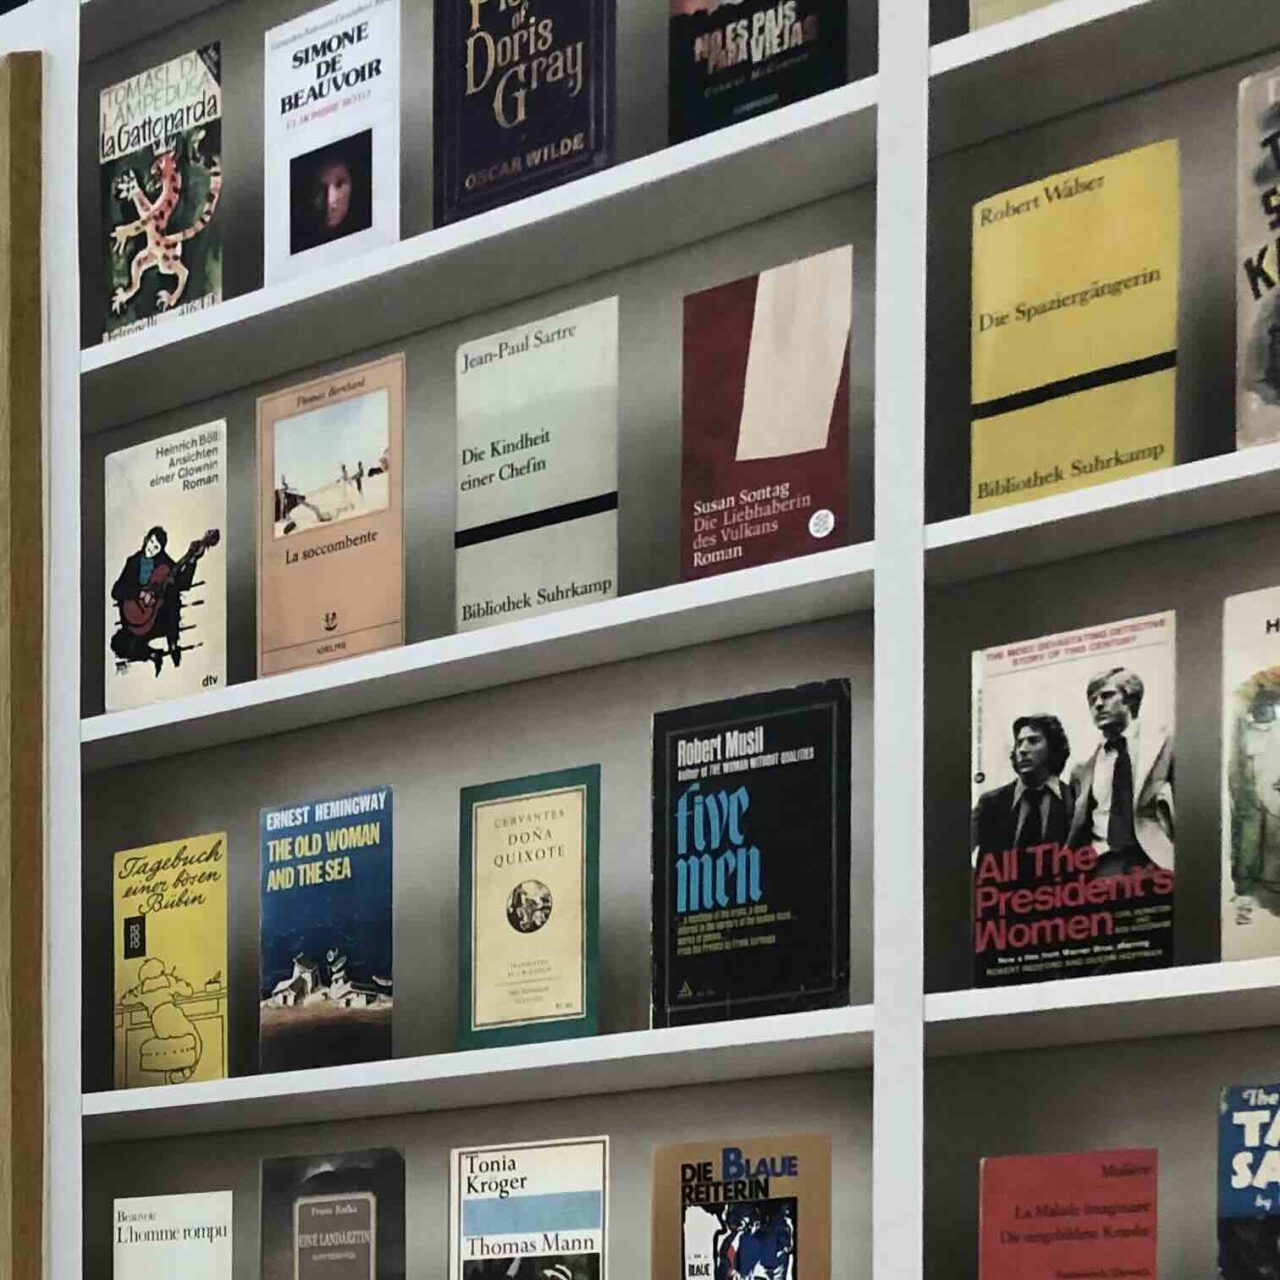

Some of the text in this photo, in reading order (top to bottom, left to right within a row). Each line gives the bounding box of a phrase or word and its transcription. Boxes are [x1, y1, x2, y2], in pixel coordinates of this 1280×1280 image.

[512, 3, 528, 30] of
[292, 22, 369, 69] SIMONE
[466, 18, 553, 96] Doris
[315, 54, 343, 79] DE
[280, 58, 382, 115] BEAUVOIR
[493, 40, 584, 129] Gray
[101, 132, 116, 158] la
[527, 132, 585, 167] WILDE
[980, 193, 1040, 227] Robert
[979, 266, 1161, 333] Die Spaziergängerin
[461, 323, 576, 374] Jean-Paul Sartre
[199, 430, 219, 449] Böll
[462, 428, 551, 466] Die Kindheit
[168, 446, 219, 470] Ansichten
[460, 458, 547, 492] einer Chefin
[977, 443, 1165, 501] Bibliothek Suhrkamp
[182, 473, 219, 491] Roman
[693, 481, 790, 516] Susan Sontag
[693, 493, 811, 533] Die Liebhaberin
[302, 530, 378, 559] soccombente
[721, 519, 778, 543] Vulkans
[693, 545, 743, 567] Roman
[461, 576, 612, 623] Bibliothek Suhrkamp
[678, 725, 764, 767] Robert Musil
[267, 791, 387, 831] ERNEST HEMINGWAY
[494, 808, 565, 830] CERVANTES
[676, 783, 750, 855] five
[268, 823, 380, 863] THE OLD WOMAN
[508, 826, 553, 846] DOÑA
[118, 840, 222, 880] Tagebuch
[493, 844, 565, 868] QUIXOTE
[978, 841, 1098, 884] All The
[267, 859, 351, 892] AND THE SEA
[676, 844, 763, 913] men
[975, 865, 1173, 919] President's
[138, 893, 206, 914] Bübin
[975, 911, 1115, 954] Women
[466, 1153, 517, 1174] Tonia
[681, 1147, 798, 1184] DIE BLAUE
[466, 1175, 528, 1199] Kröger
[682, 1179, 769, 1203] REITERIN
[466, 1232, 595, 1257] Thomas Mann
